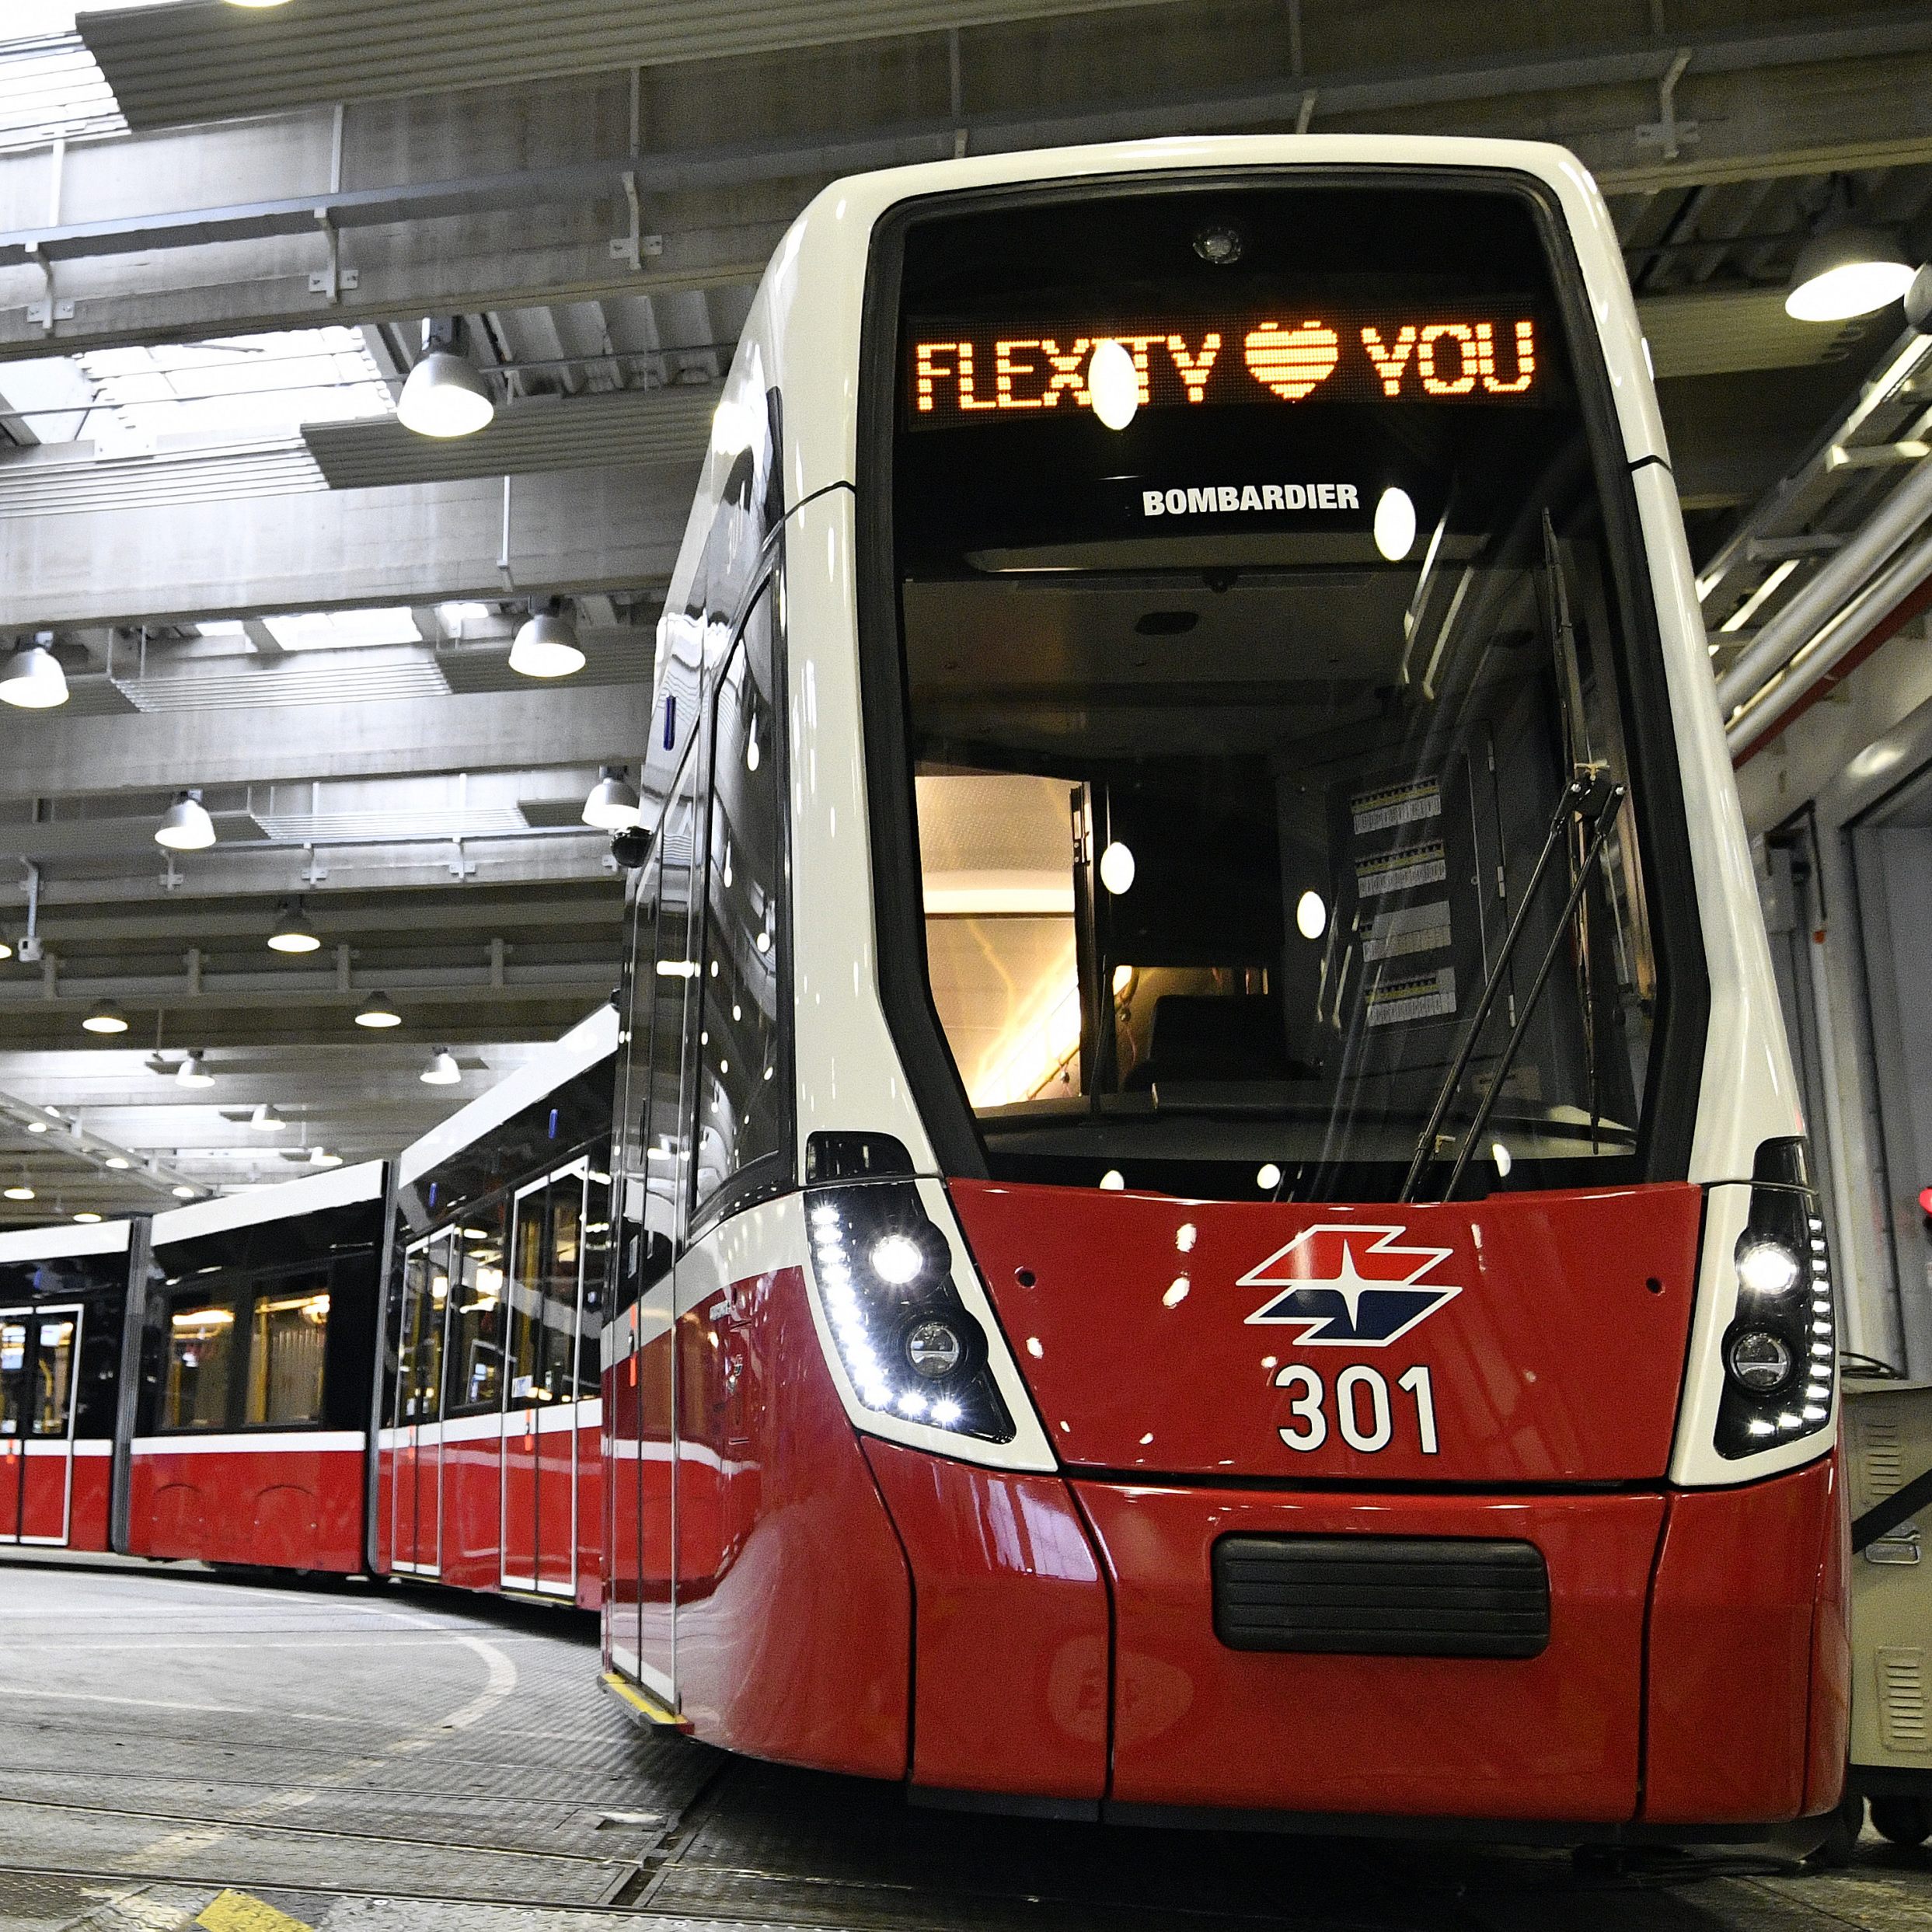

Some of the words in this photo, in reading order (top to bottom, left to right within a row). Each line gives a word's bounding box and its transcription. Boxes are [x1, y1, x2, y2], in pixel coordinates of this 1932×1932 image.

[916, 333, 1221, 410] FLEXTY
[1362, 321, 1535, 397] YOU
[1142, 483, 1359, 516] BOMBARDIER
[1275, 1364, 1439, 1455] 301
